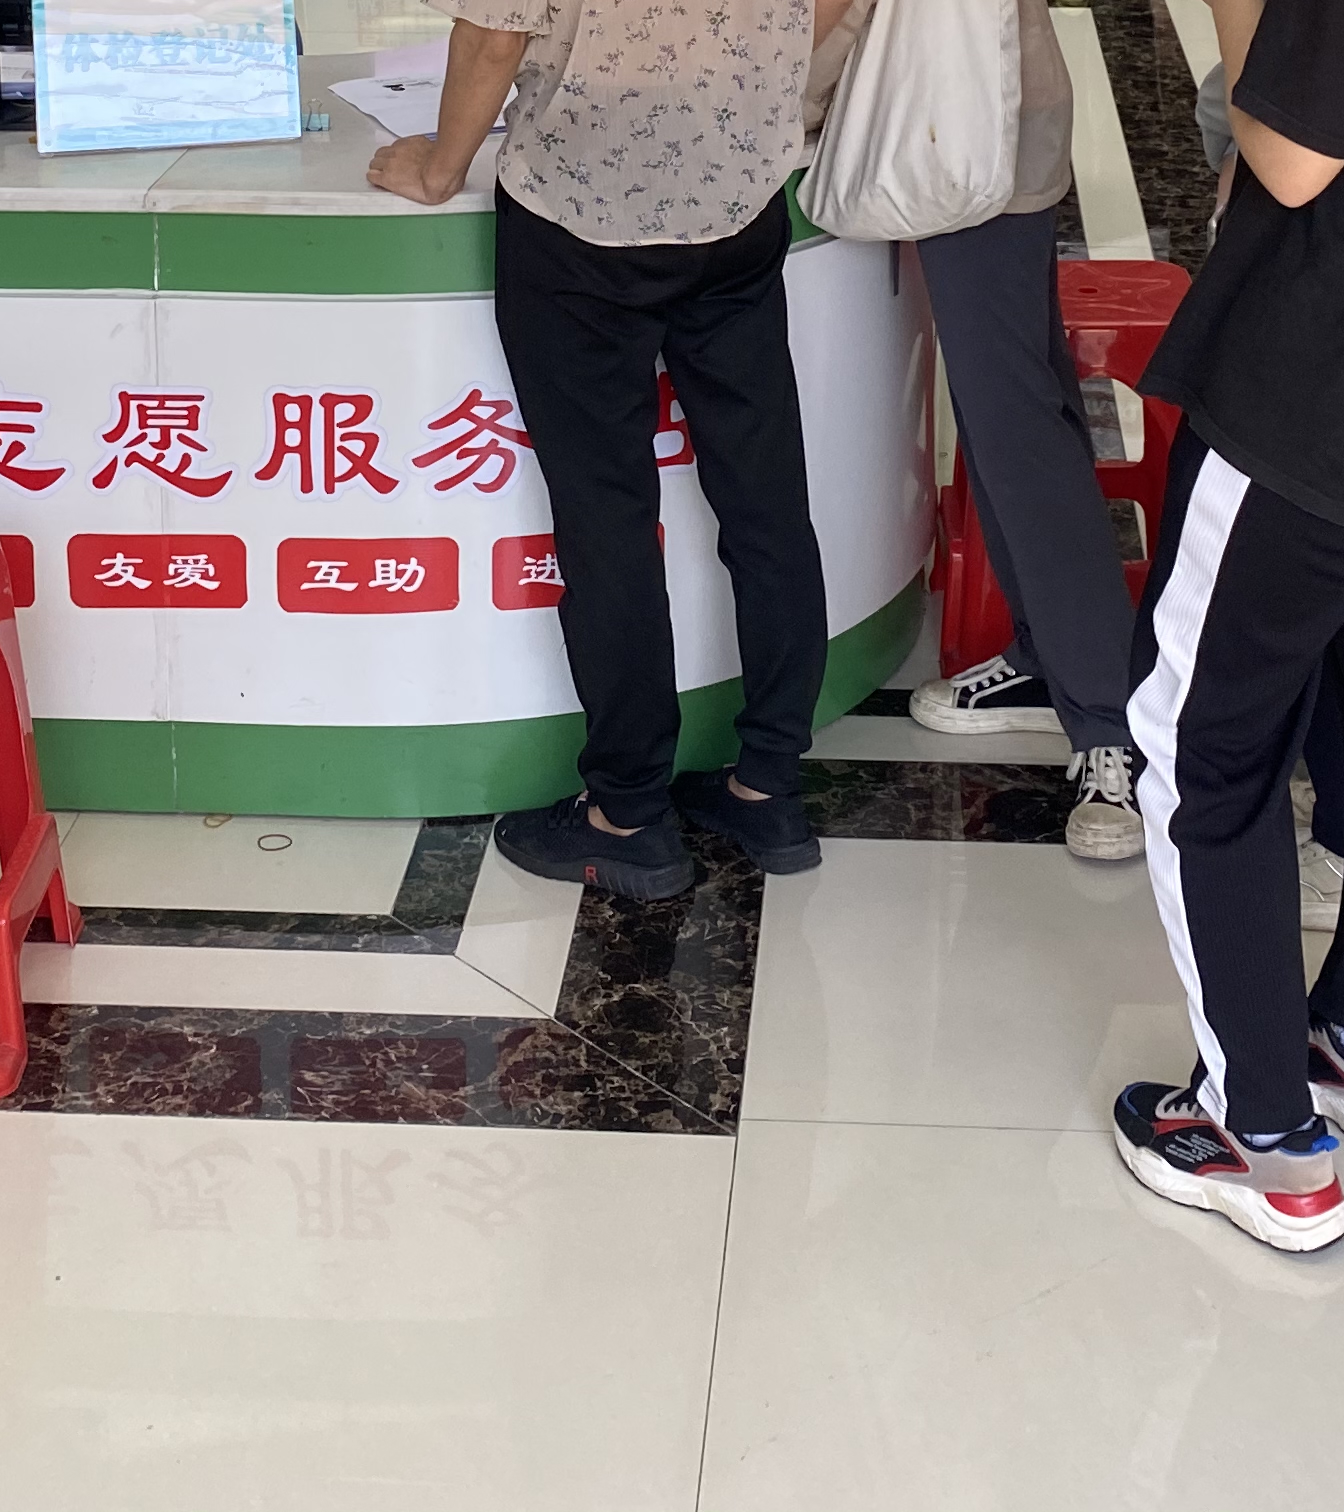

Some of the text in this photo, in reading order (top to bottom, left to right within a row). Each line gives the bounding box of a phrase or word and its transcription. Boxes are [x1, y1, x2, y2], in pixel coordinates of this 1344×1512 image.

[93, 552, 221, 590] 友爱
[299, 556, 426, 593] 互助
[518, 552, 567, 587] 进
[585, 865, 599, 884] R
